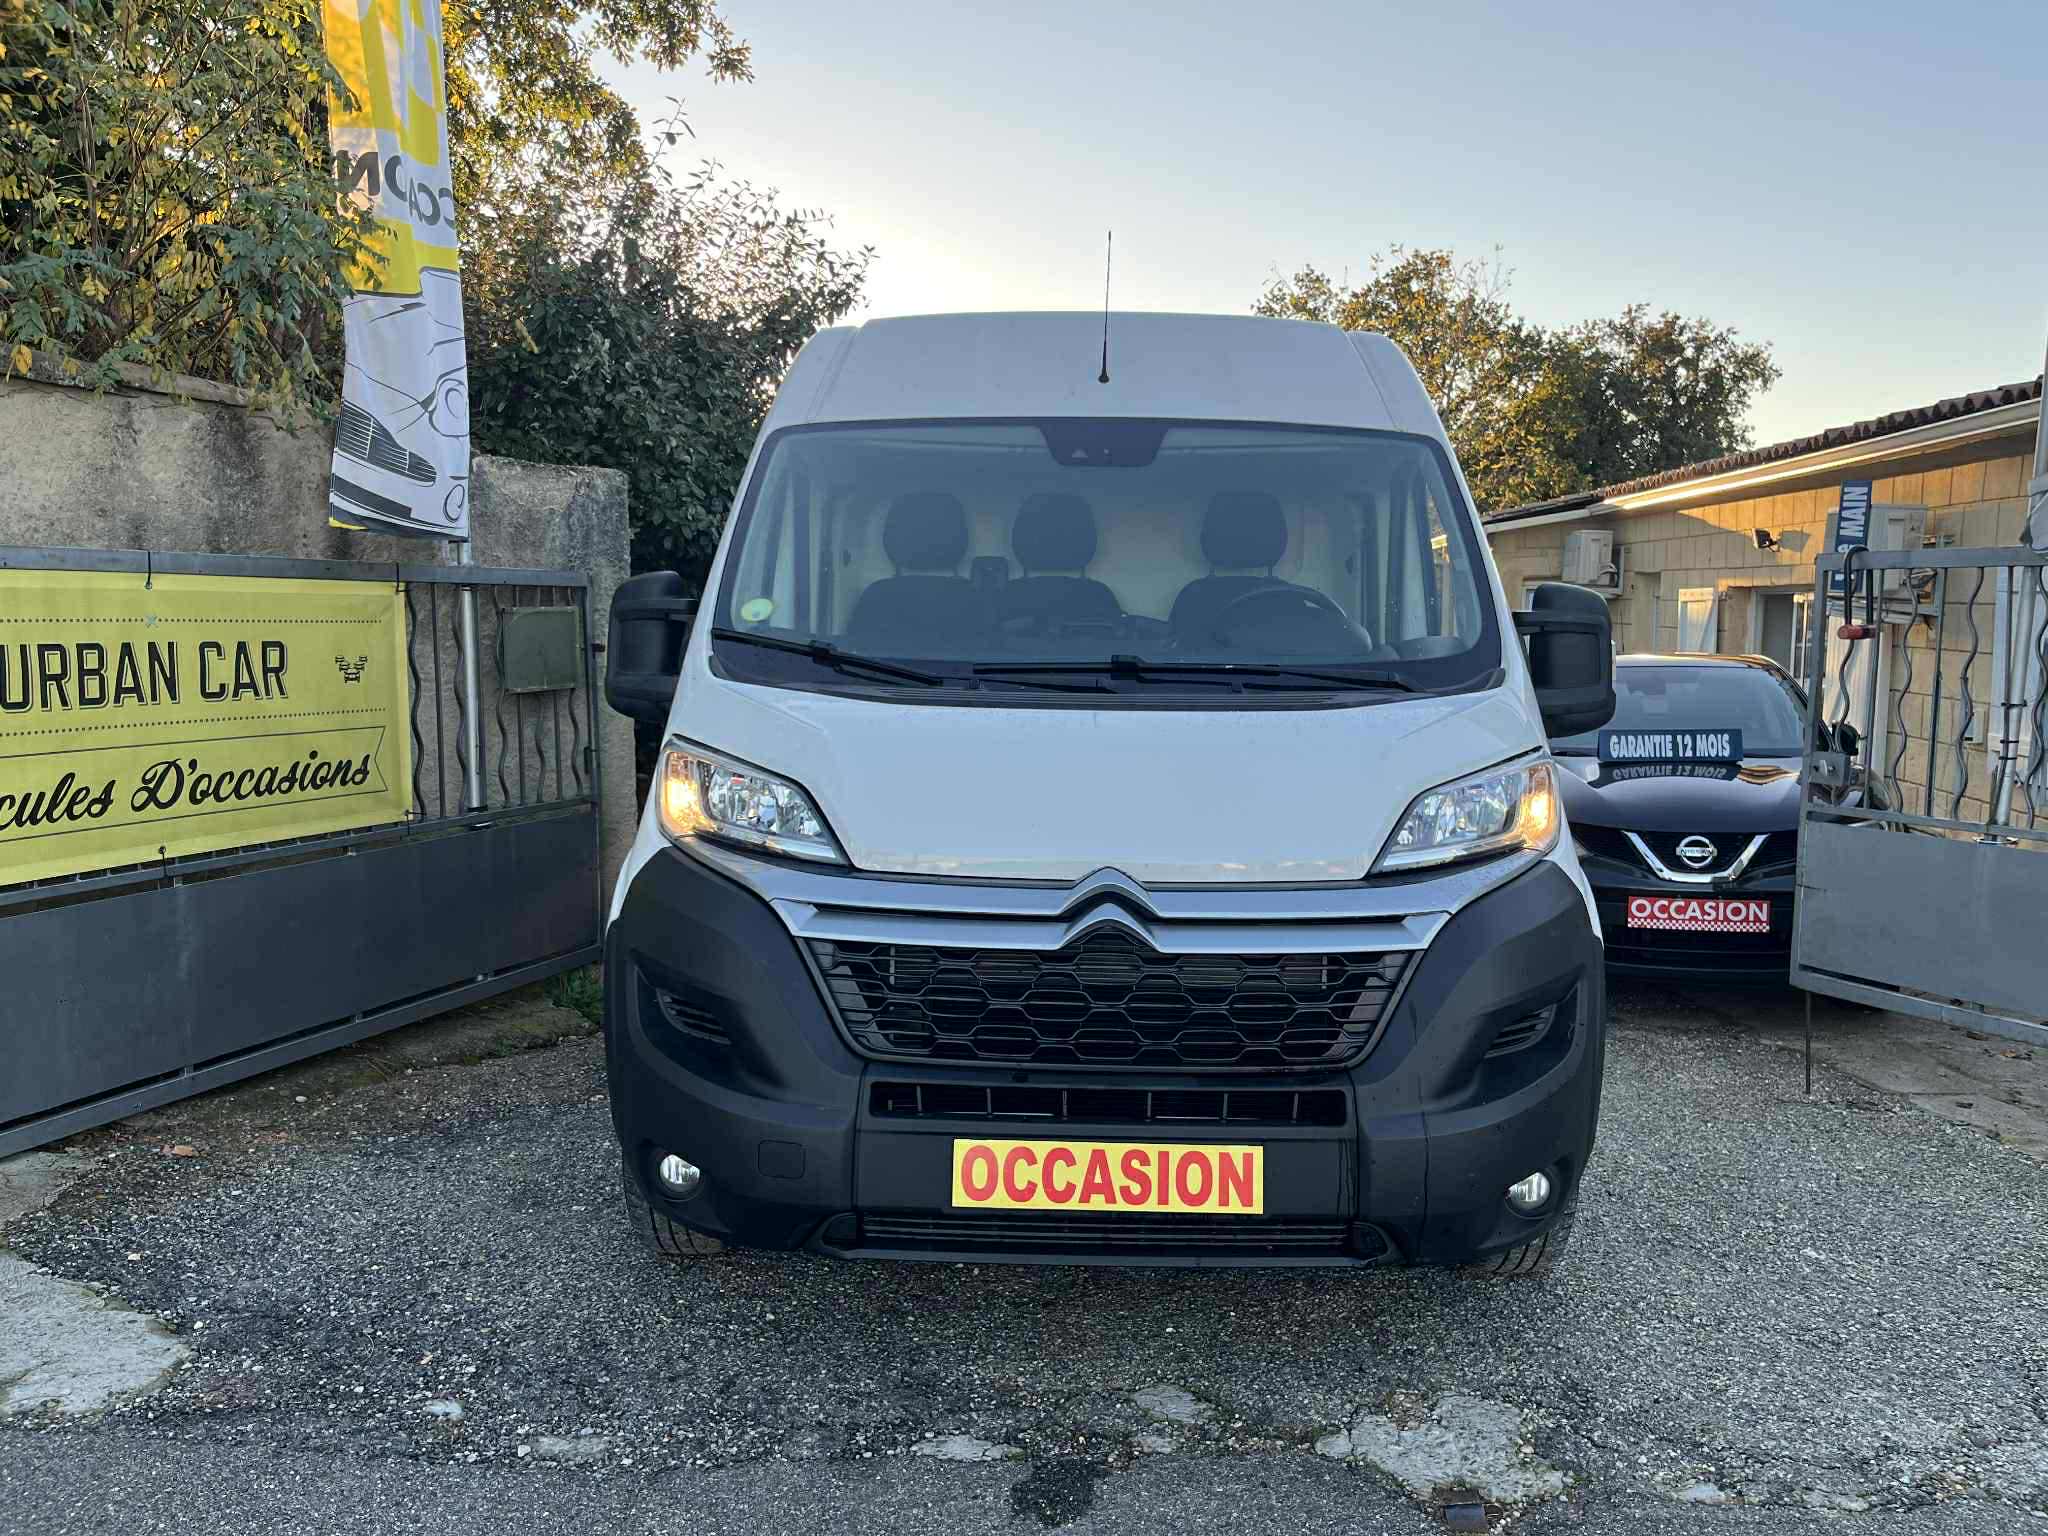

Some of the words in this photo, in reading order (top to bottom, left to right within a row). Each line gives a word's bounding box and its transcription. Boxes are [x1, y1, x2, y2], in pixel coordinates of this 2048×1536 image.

[1840, 487, 1868, 537] MAIN
[0, 640, 180, 713] URBAN
[198, 640, 288, 701] CAR
[1609, 735, 1673, 758] GARANTIE
[1677, 734, 1693, 757] 12
[1696, 733, 1730, 757] MOIS
[131, 750, 371, 813] D'occasions
[1630, 899, 1769, 922] OCCASION
[961, 1144, 1254, 1208] OCCASION
